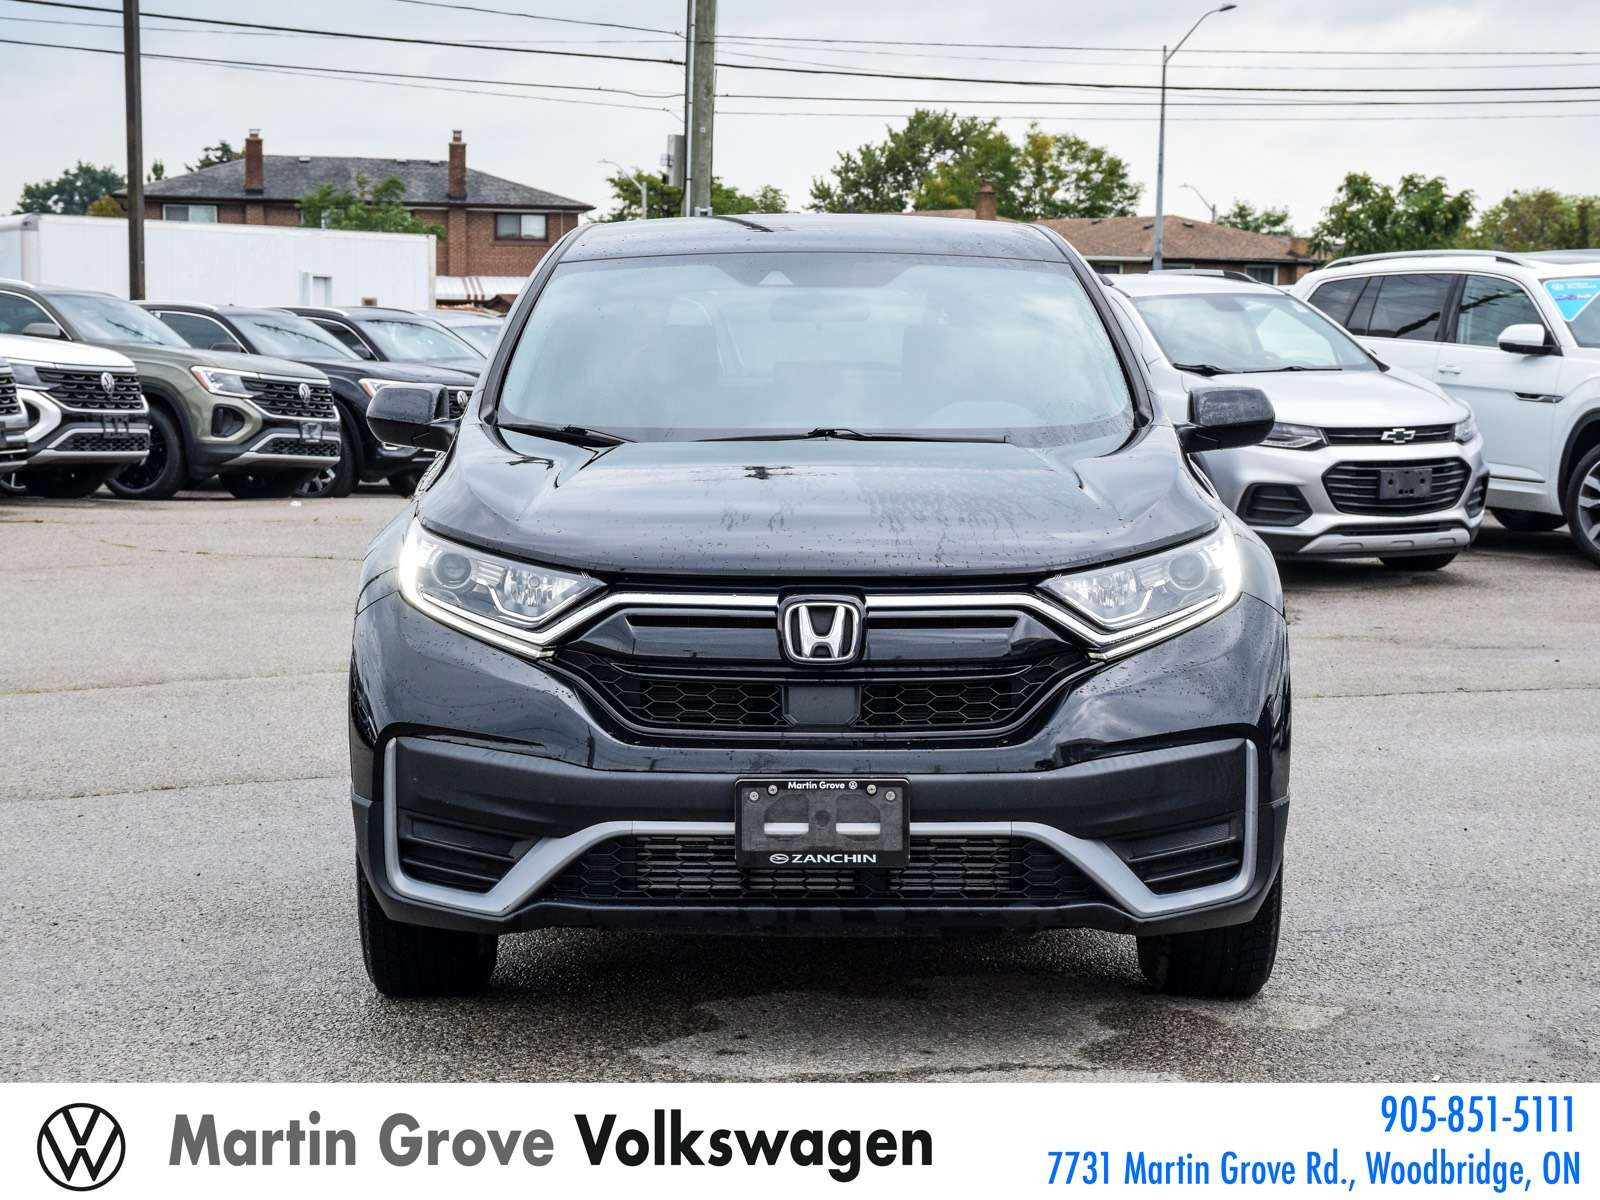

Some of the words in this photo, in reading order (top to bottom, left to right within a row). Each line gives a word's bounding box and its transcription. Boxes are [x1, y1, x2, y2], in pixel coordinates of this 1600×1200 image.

[787, 781, 818, 790] Martin
[819, 781, 846, 790] Grove
[791, 853, 877, 864] ZANCHIN
